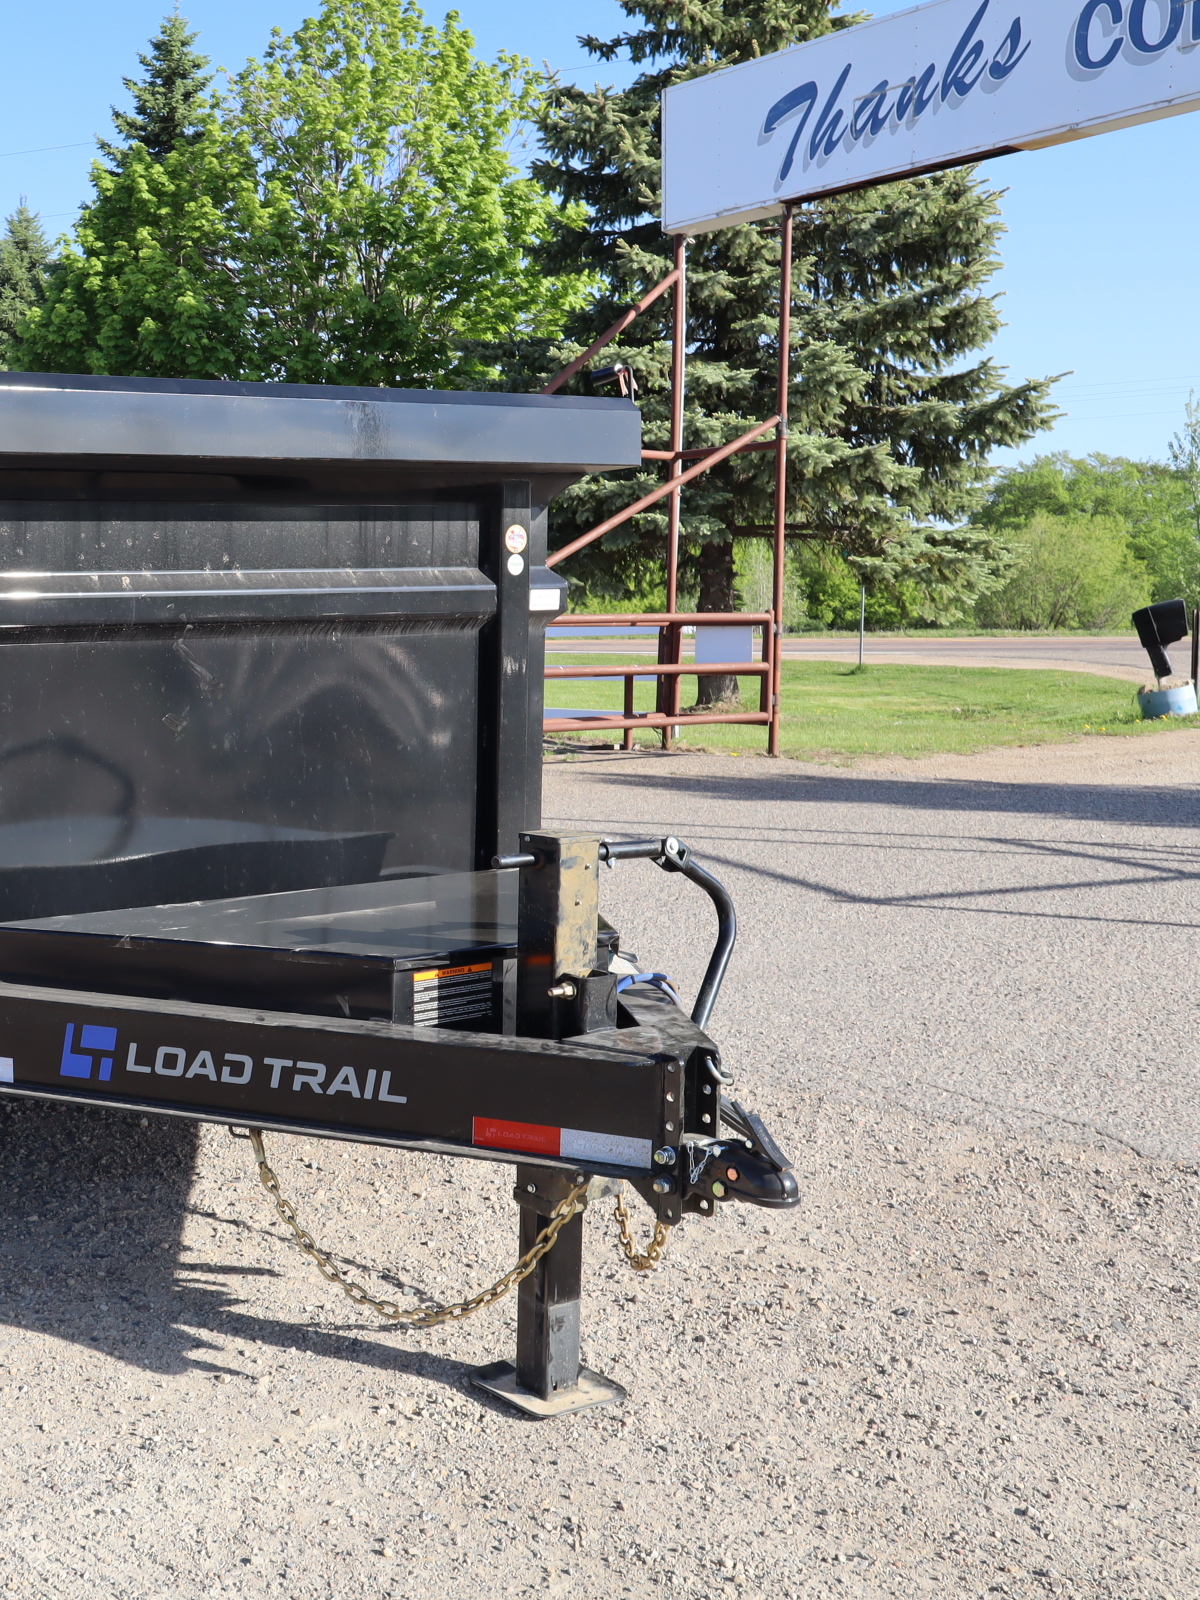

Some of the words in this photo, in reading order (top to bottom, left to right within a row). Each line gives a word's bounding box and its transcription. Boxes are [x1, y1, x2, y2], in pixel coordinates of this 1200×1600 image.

[763, 0, 1032, 182] Thanks
[126, 1042, 253, 1085] LOAD
[263, 1057, 408, 1104] TRAIL
[498, 1131, 521, 1139] LOAD
[521, 1134, 546, 1143] TRAIL
